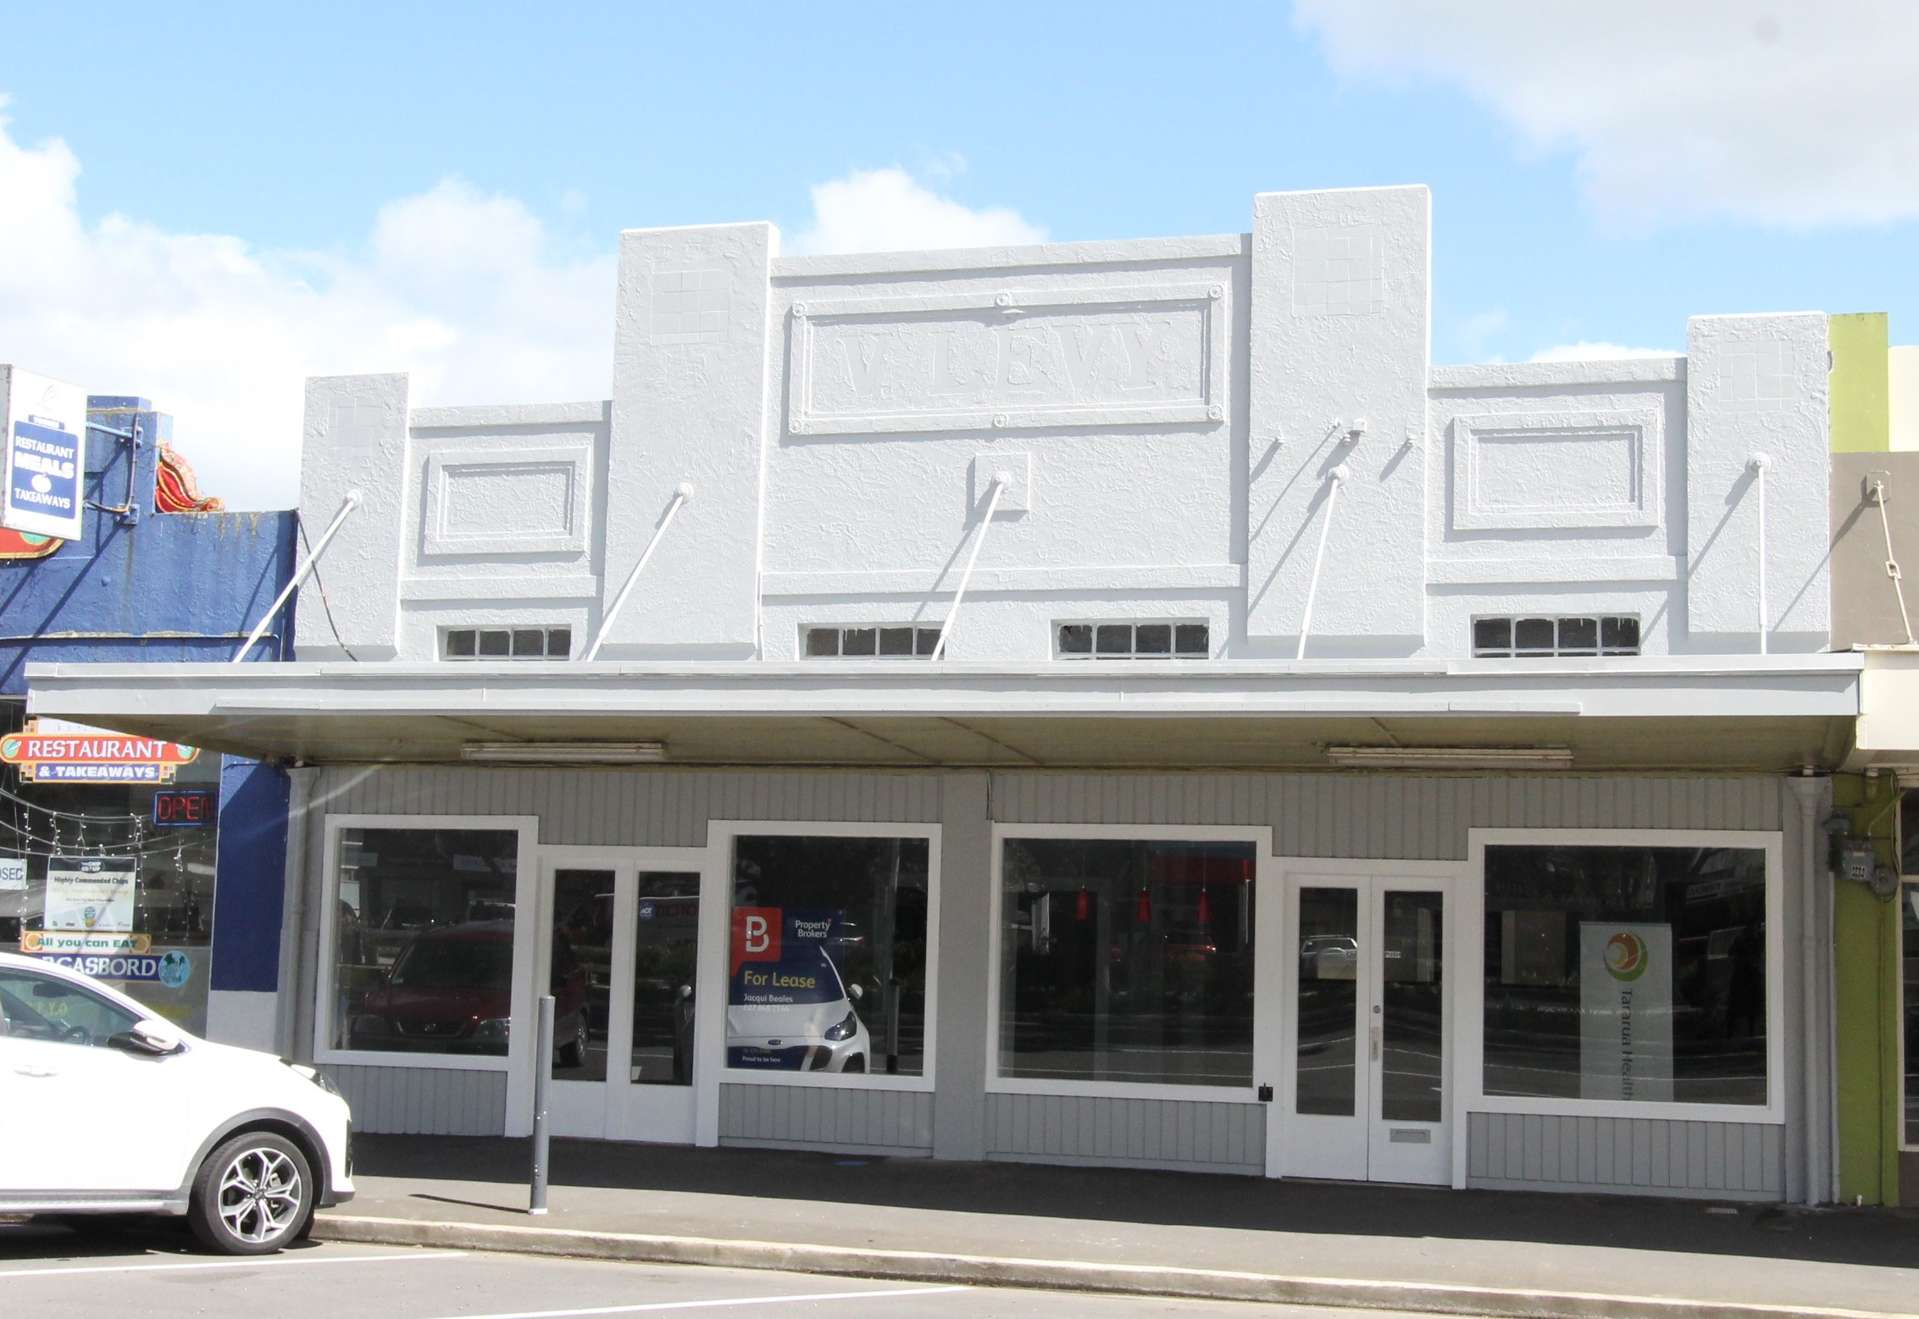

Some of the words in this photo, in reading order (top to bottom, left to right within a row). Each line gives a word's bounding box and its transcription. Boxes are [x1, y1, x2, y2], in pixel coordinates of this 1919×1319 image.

[15, 435, 75, 460] RESTAURANT
[14, 451, 75, 480] MEALS
[15, 487, 71, 509] TAKEAWAYS
[27, 740, 168, 759] RESTAURANT
[38, 765, 51, 777] &
[54, 765, 156, 778] TAKEAWAYS
[0, 866, 23, 881] SED
[795, 919, 831, 931] Property
[797, 928, 827, 938] Brokers
[37, 937, 53, 946] All
[57, 939, 81, 948] you
[86, 939, 109, 947] can
[113, 939, 138, 948] EAT
[744, 970, 768, 986] For
[772, 972, 816, 988] Lease
[1621, 988, 1633, 1046] Tararua
